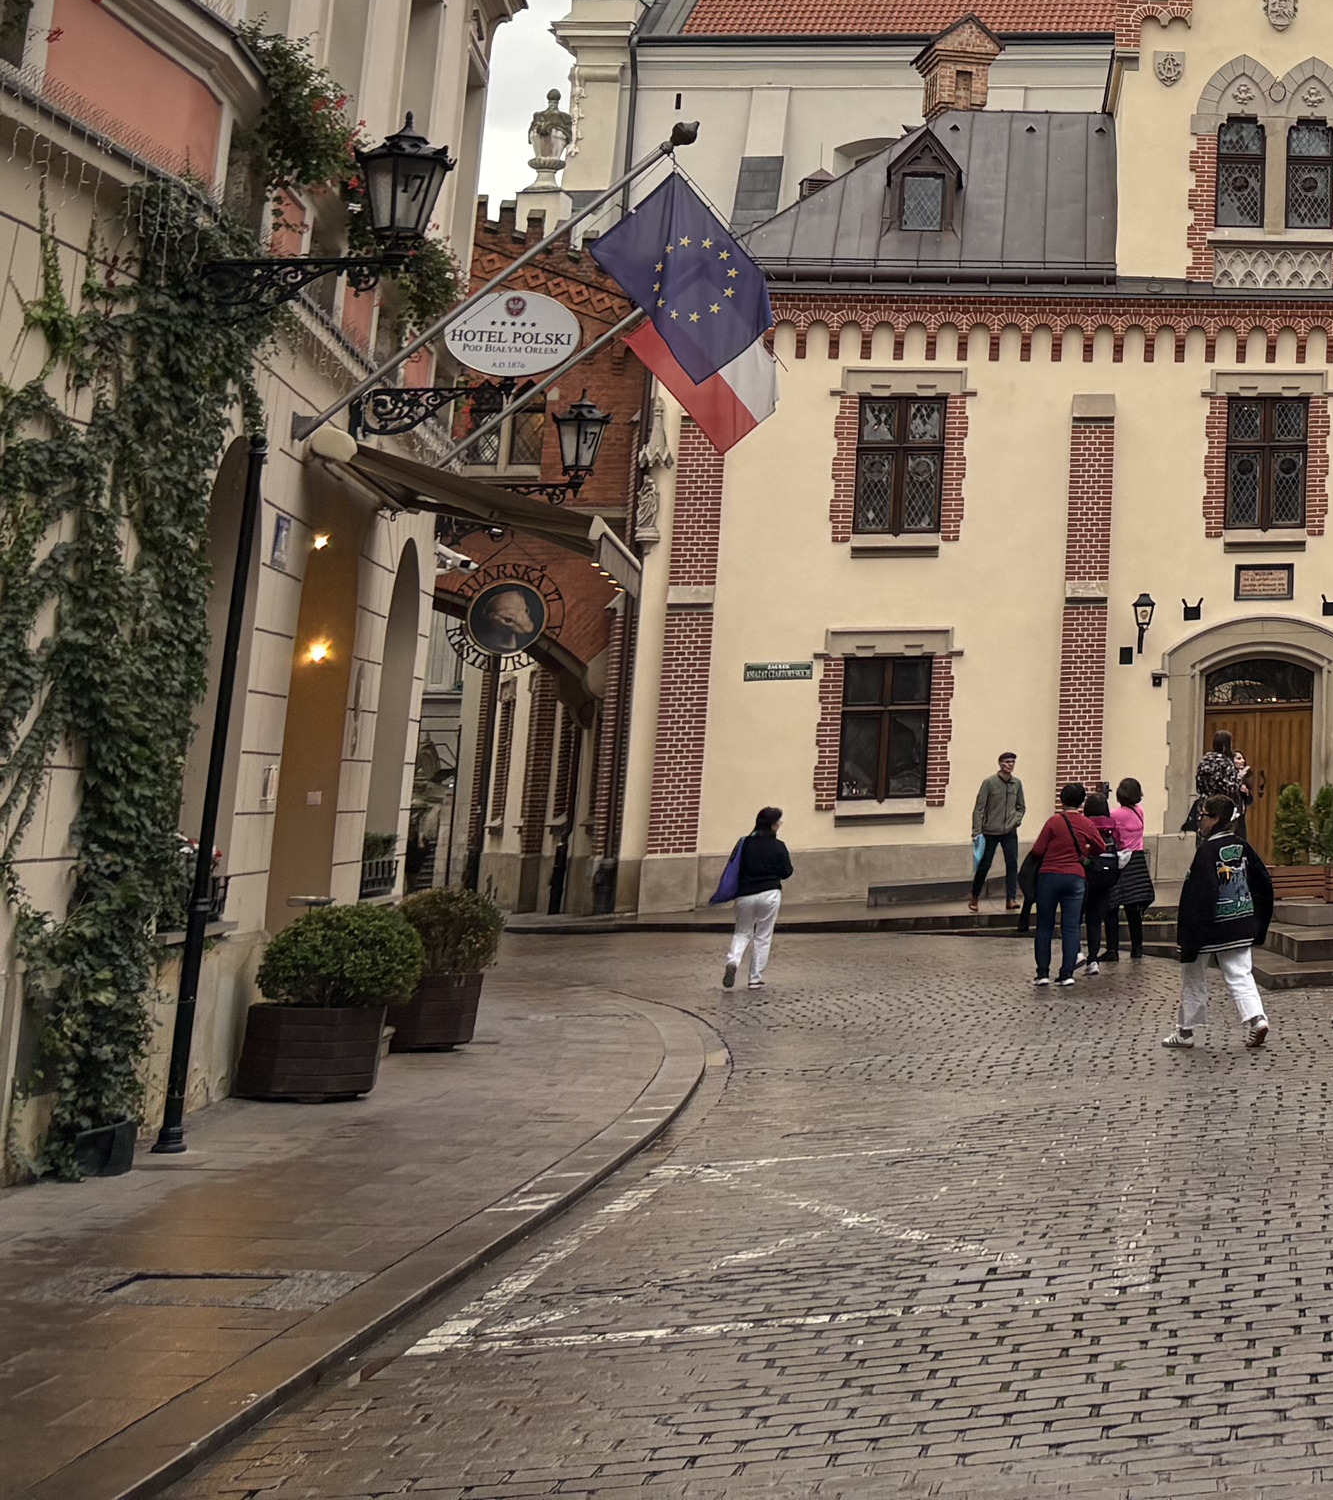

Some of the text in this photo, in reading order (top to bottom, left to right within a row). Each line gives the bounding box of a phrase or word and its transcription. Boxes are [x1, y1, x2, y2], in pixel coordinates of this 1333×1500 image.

[401, 173, 426, 202] 17
[451, 329, 573, 346] HOTEL POLSKI
[583, 431, 597, 450] 17
